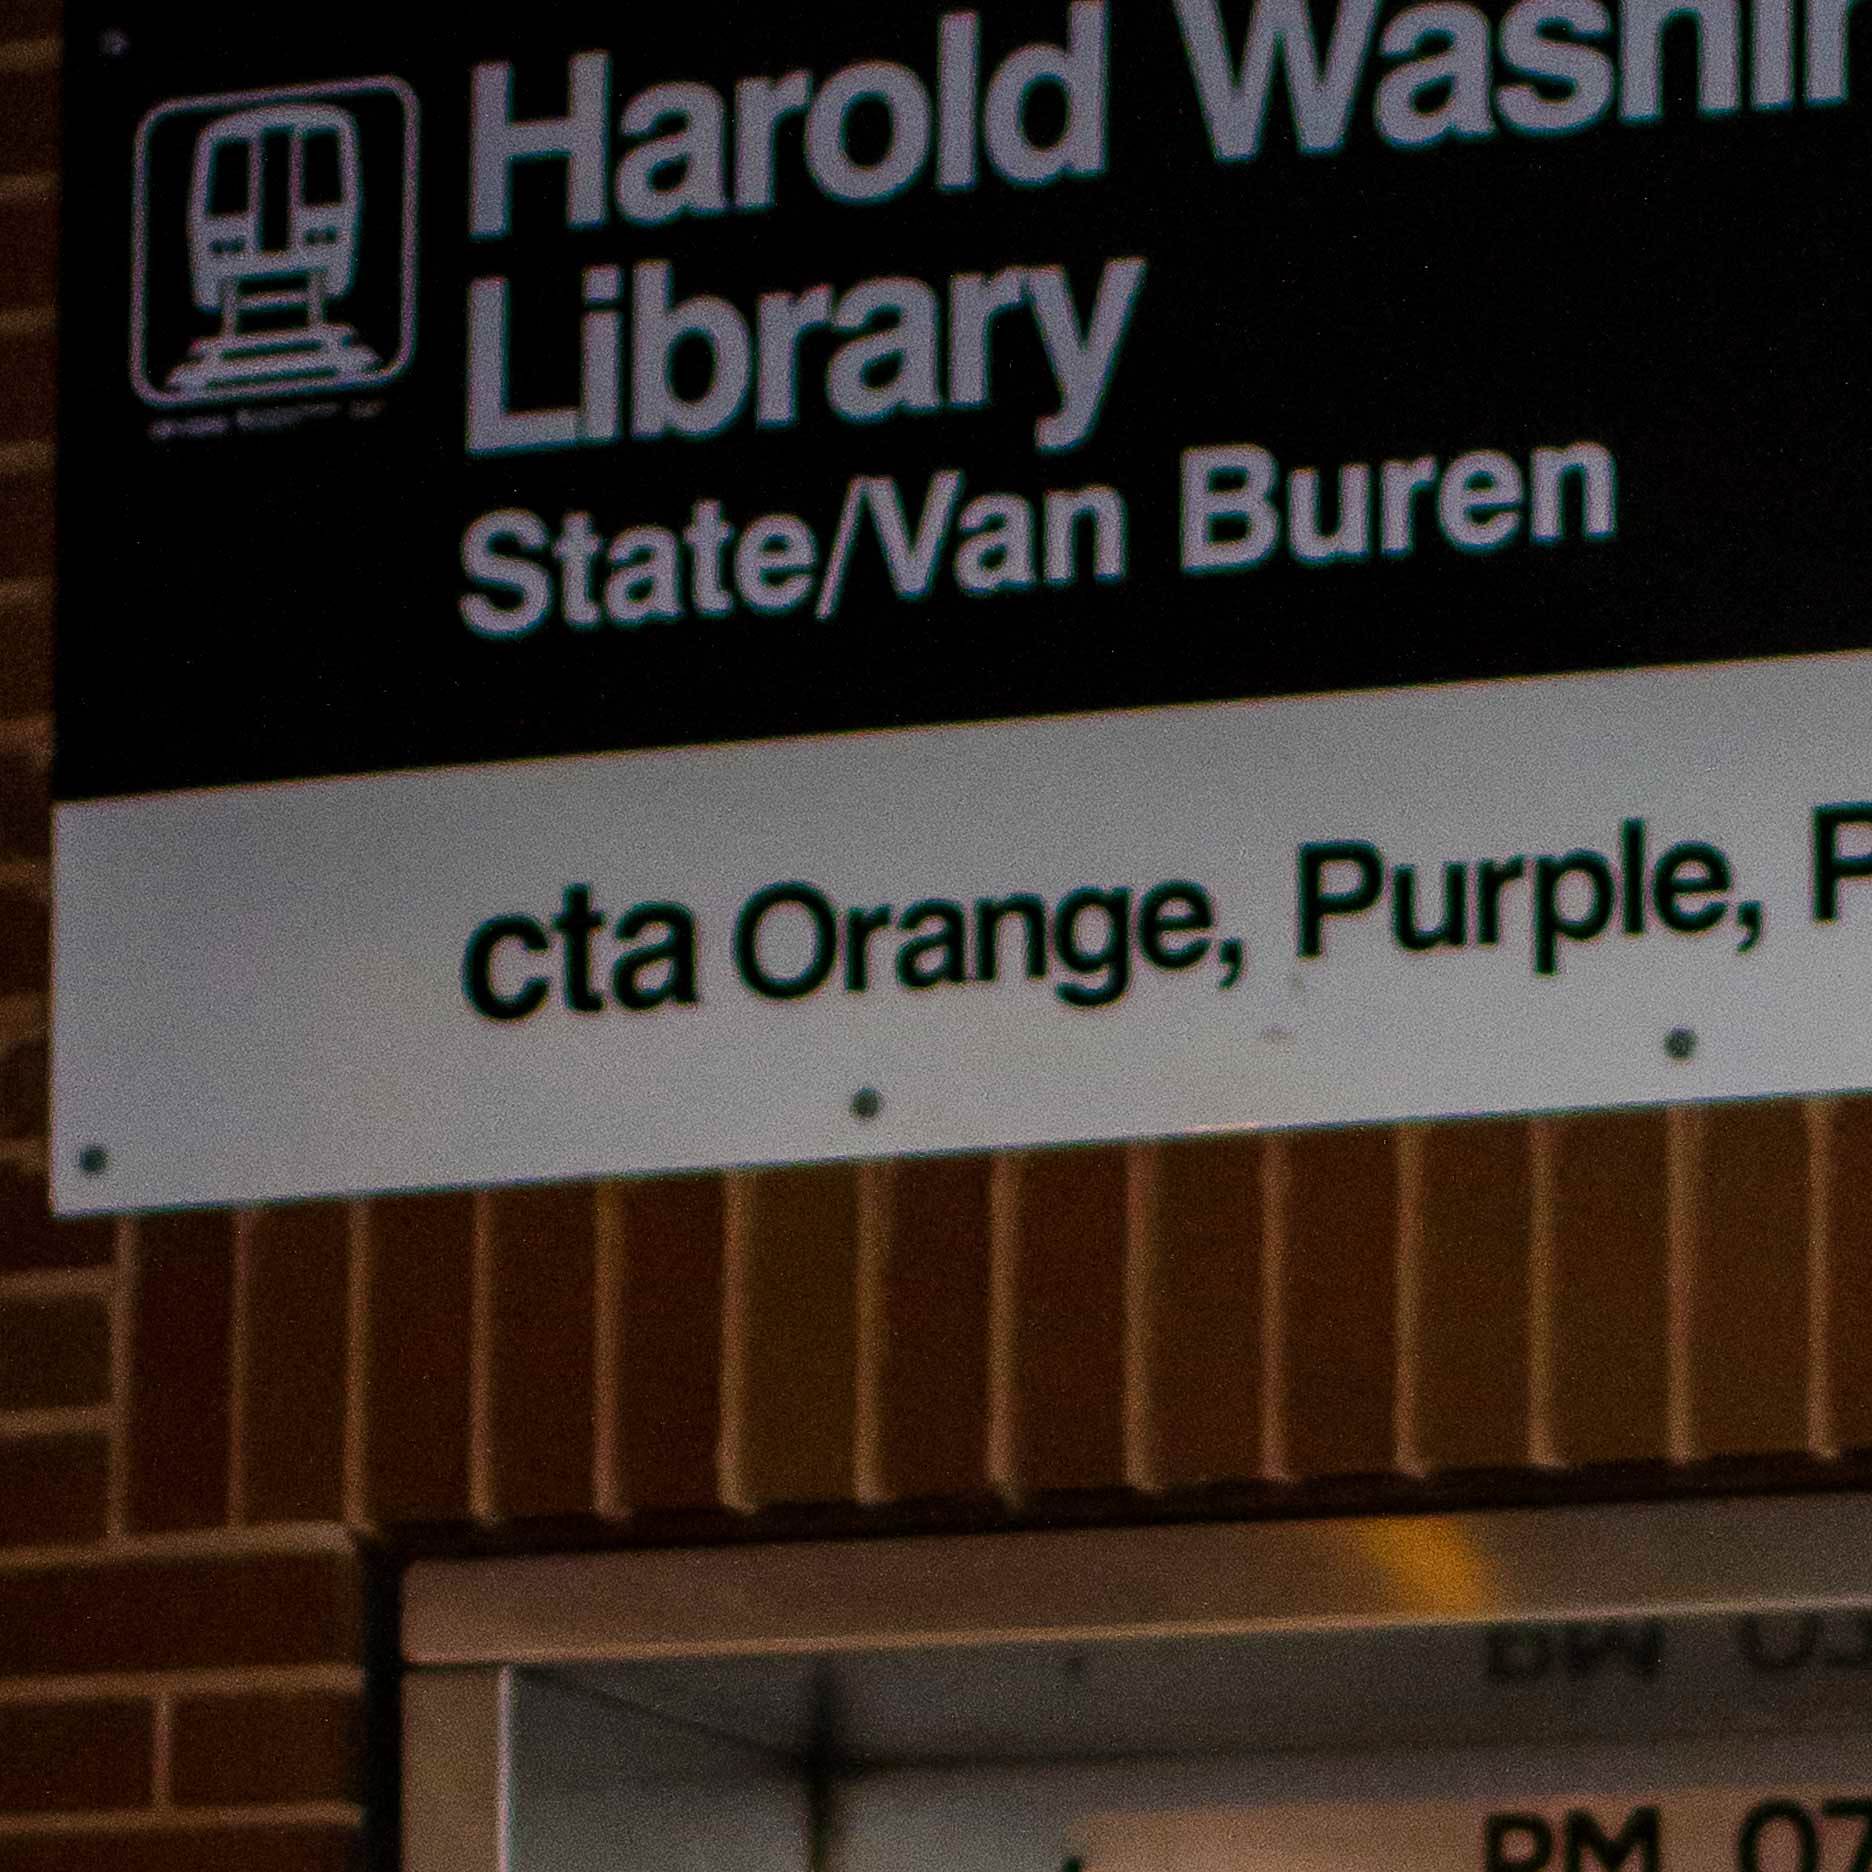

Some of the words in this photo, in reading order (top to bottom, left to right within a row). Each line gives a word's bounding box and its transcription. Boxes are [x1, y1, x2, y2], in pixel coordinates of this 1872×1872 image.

[468, 0, 1108, 238] Harold
[466, 256, 1146, 455] Library
[460, 474, 1126, 638] State/Van
[1181, 441, 1616, 572] Buren
[462, 882, 701, 1024] cta
[732, 880, 1245, 1010] Orange,
[1296, 817, 1764, 977] Purple,
